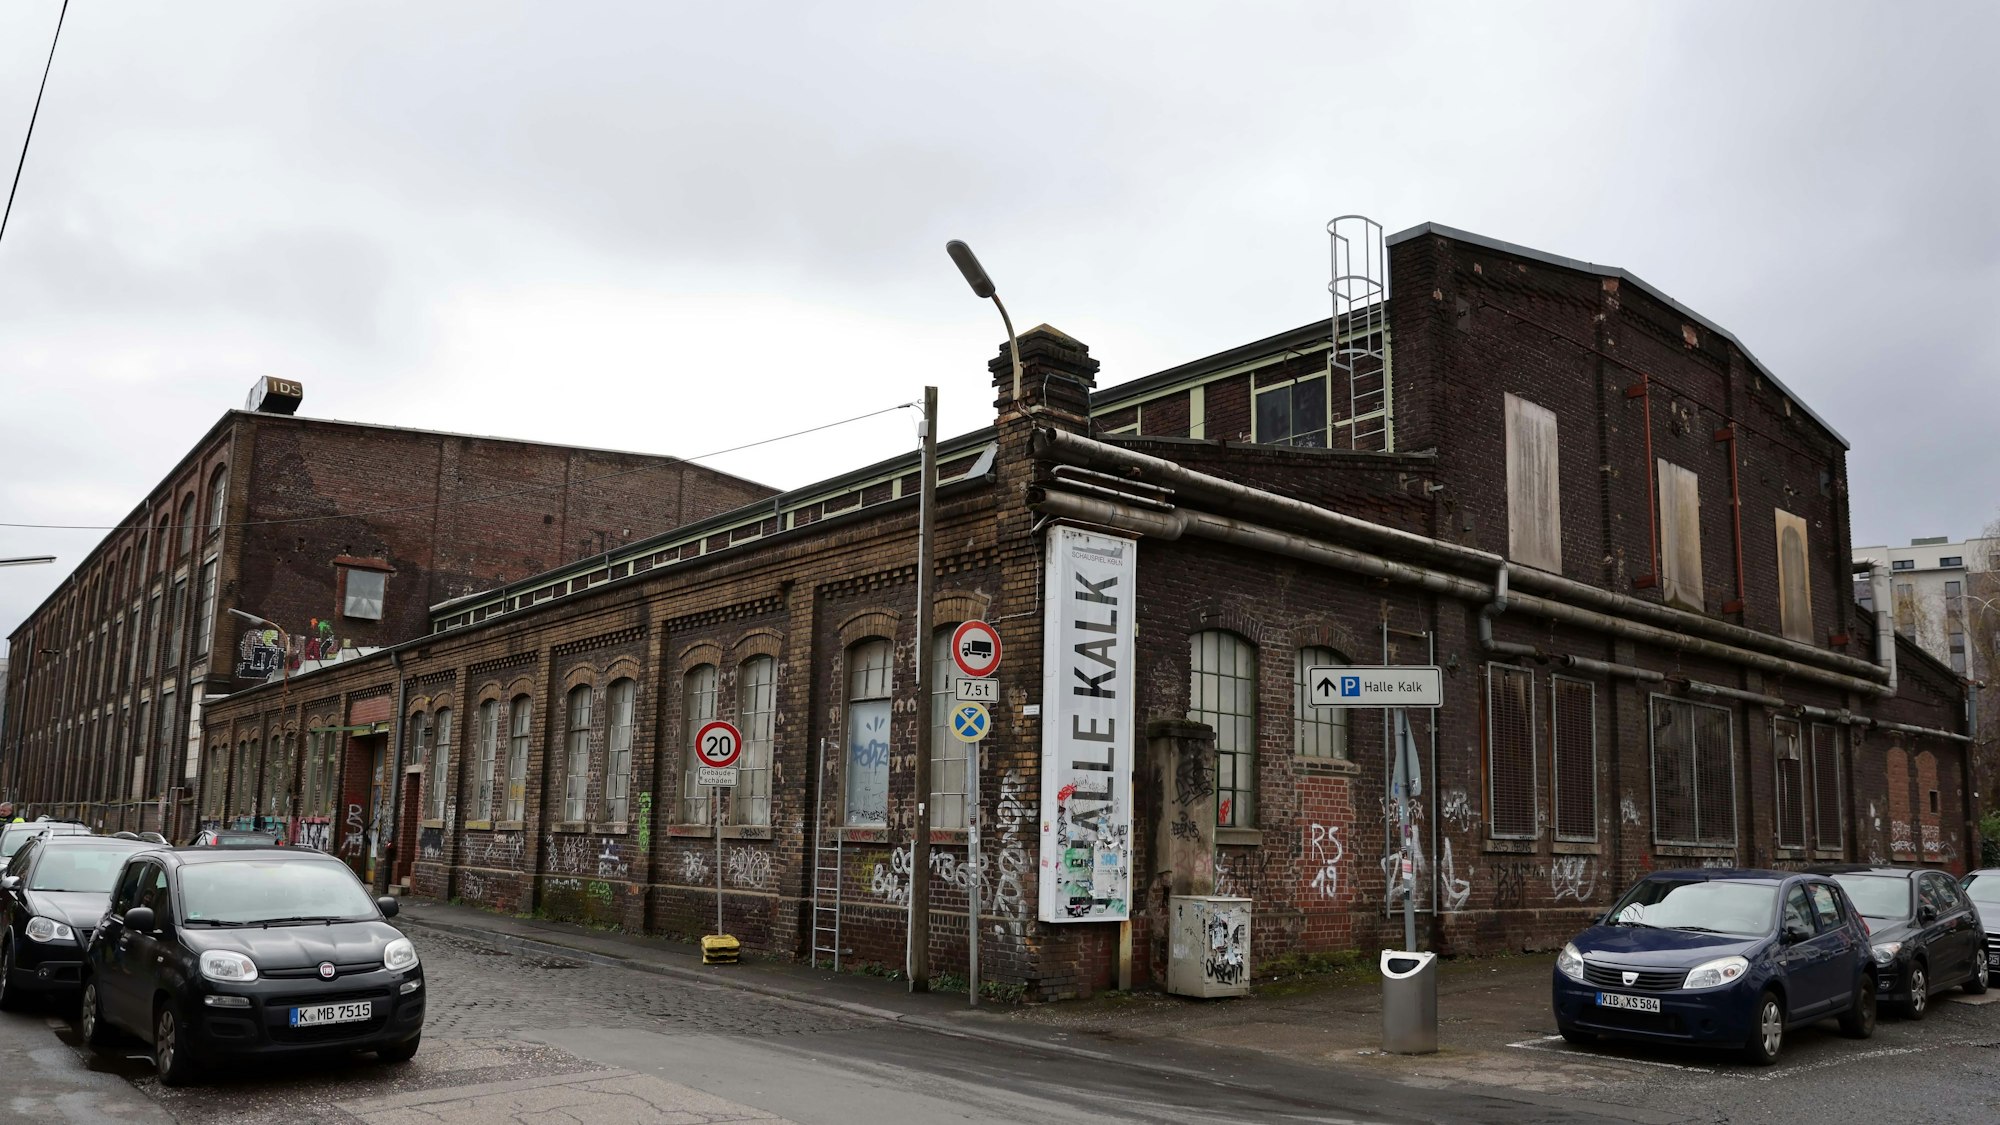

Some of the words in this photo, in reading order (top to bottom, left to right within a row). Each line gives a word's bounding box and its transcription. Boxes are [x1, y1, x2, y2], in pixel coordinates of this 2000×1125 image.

[273, 380, 302, 397] IDS
[1071, 550, 1107, 564] SCHAUSPIEL
[1074, 570, 1118, 699] KALK
[1344, 678, 1356, 695] P
[1364, 681, 1394, 692] Halle
[1398, 681, 1423, 692] Kalk
[706, 736, 731, 756] 20
[1311, 865, 1337, 899] 19
[1602, 993, 1619, 1006] KIB
[1625, 997, 1638, 1008] XS
[1640, 998, 1658, 1011] 584
[299, 1008, 308, 1022] K
[317, 1007, 335, 1021] MB
[338, 1003, 370, 1019] 7515
